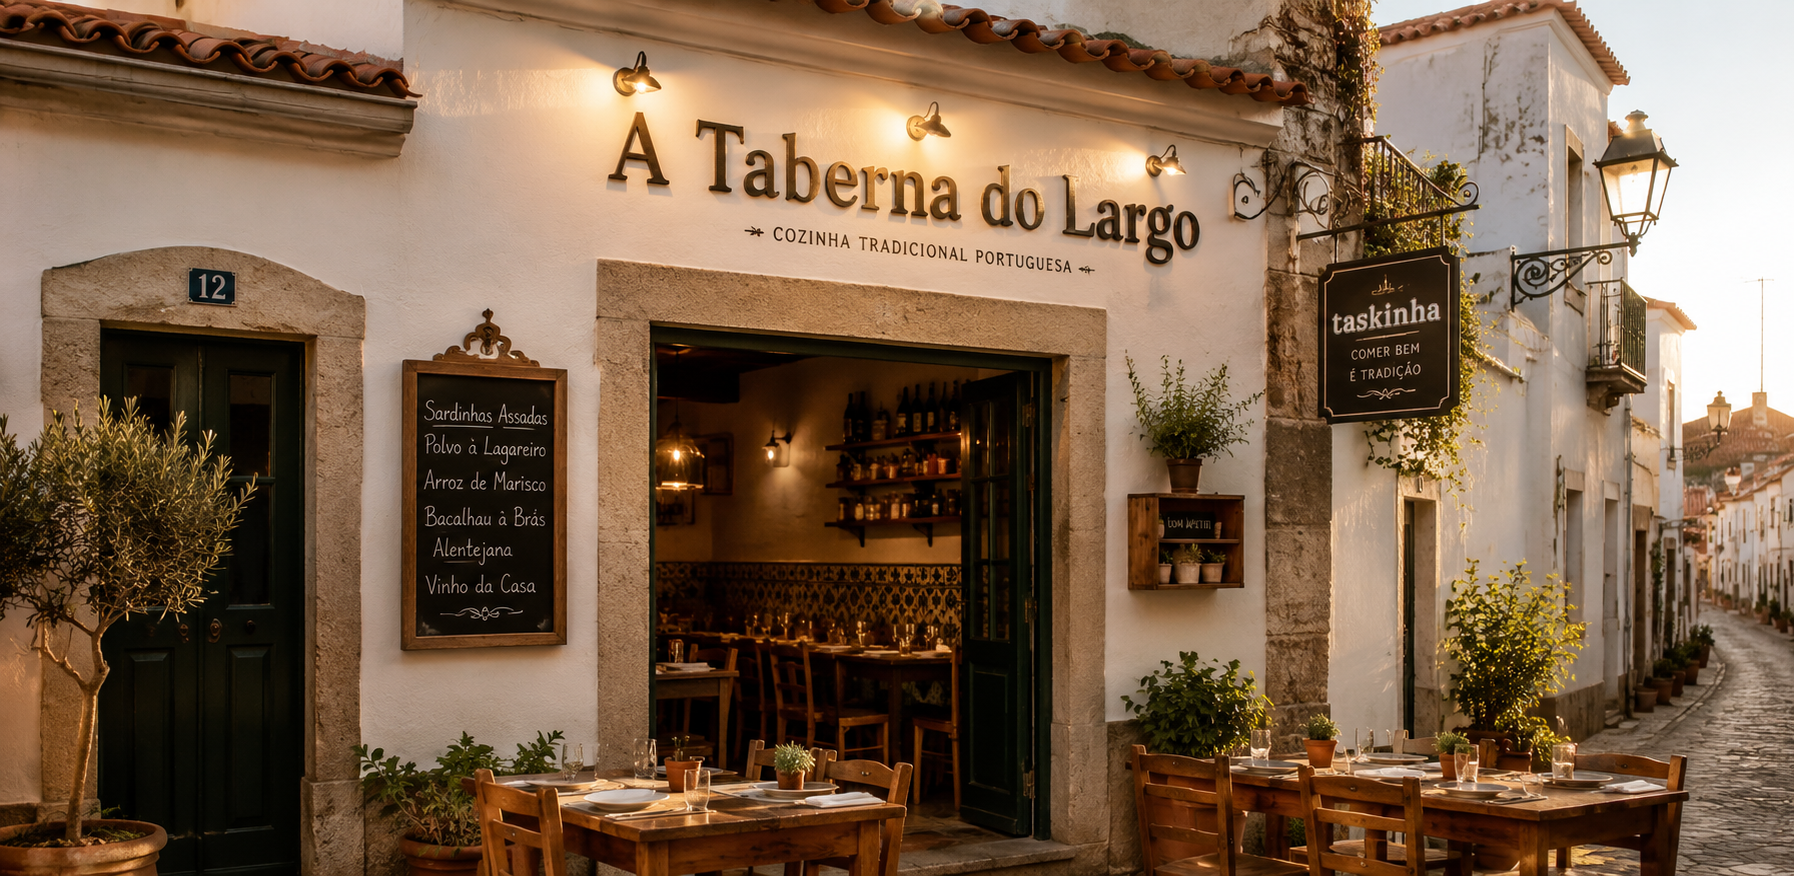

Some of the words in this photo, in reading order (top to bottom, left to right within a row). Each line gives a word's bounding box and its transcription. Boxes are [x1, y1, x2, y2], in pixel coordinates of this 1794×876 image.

[608, 111, 670, 186] A
[696, 119, 962, 221] Taberna
[980, 164, 1045, 231] do
[1062, 174, 1200, 265] Largo
[773, 226, 850, 249] COZINHA
[858, 236, 968, 262] TRADICIONAL
[976, 249, 1072, 274] PORTUGUESA
[198, 273, 226, 300] 12
[1331, 297, 1441, 336] taskinha
[1350, 345, 1391, 360] COMER
[1395, 342, 1420, 356] BEM
[1349, 367, 1357, 382] É
[423, 399, 493, 422] Sardinhas
[498, 403, 548, 426] Assadas
[424, 433, 462, 455] Polvo
[468, 437, 478, 455] à
[483, 435, 547, 466] Lagareiro
[423, 468, 464, 490] Arroz
[470, 471, 488, 491] de
[493, 471, 547, 492] Marisco
[424, 505, 492, 527] Bacalhau
[432, 537, 514, 566] Alentejana
[425, 574, 469, 595] Vinho
[475, 574, 494, 594] da
[500, 573, 537, 594] Casa
